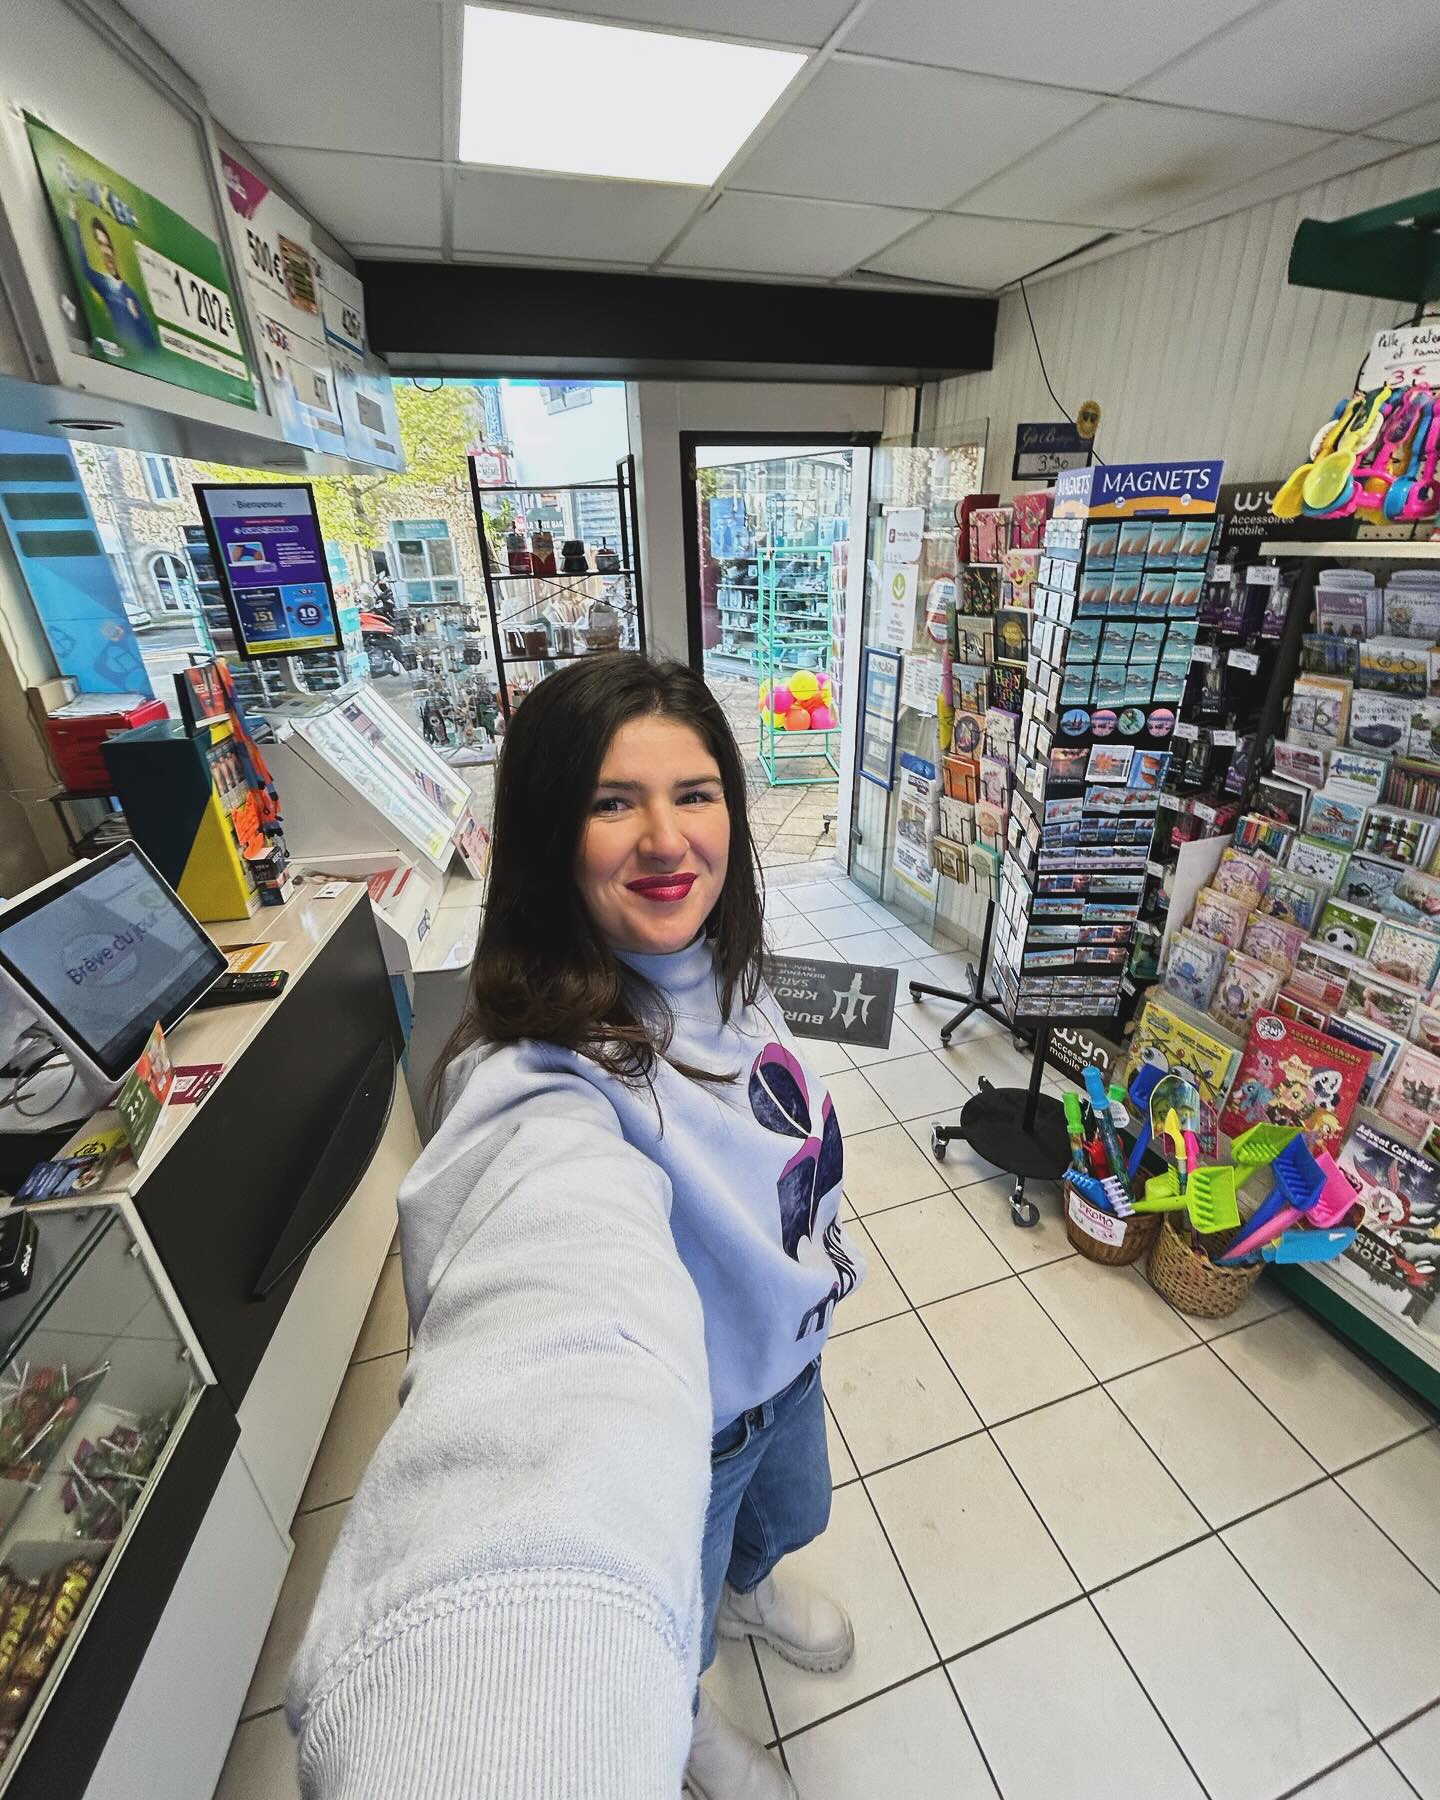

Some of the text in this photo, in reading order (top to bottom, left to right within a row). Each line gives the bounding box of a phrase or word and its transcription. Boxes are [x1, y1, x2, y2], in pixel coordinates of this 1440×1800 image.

[1057, 474, 1091, 496] MAGNETS
[1102, 468, 1211, 493] MAGNETS
[1228, 525, 1268, 535] mobile.
[299, 607, 318, 618] 10
[66, 947, 113, 985] Brève
[113, 929, 135, 951] du
[783, 1009, 825, 1026] BUR
[1050, 1036, 1091, 1067] Accesso
[1320, 1042, 1362, 1064] CALENDAR
[1356, 1124, 1434, 1173] Advent Calendar
[1080, 1200, 1114, 1228] PROMO
[1356, 1232, 1394, 1261] GHTY
